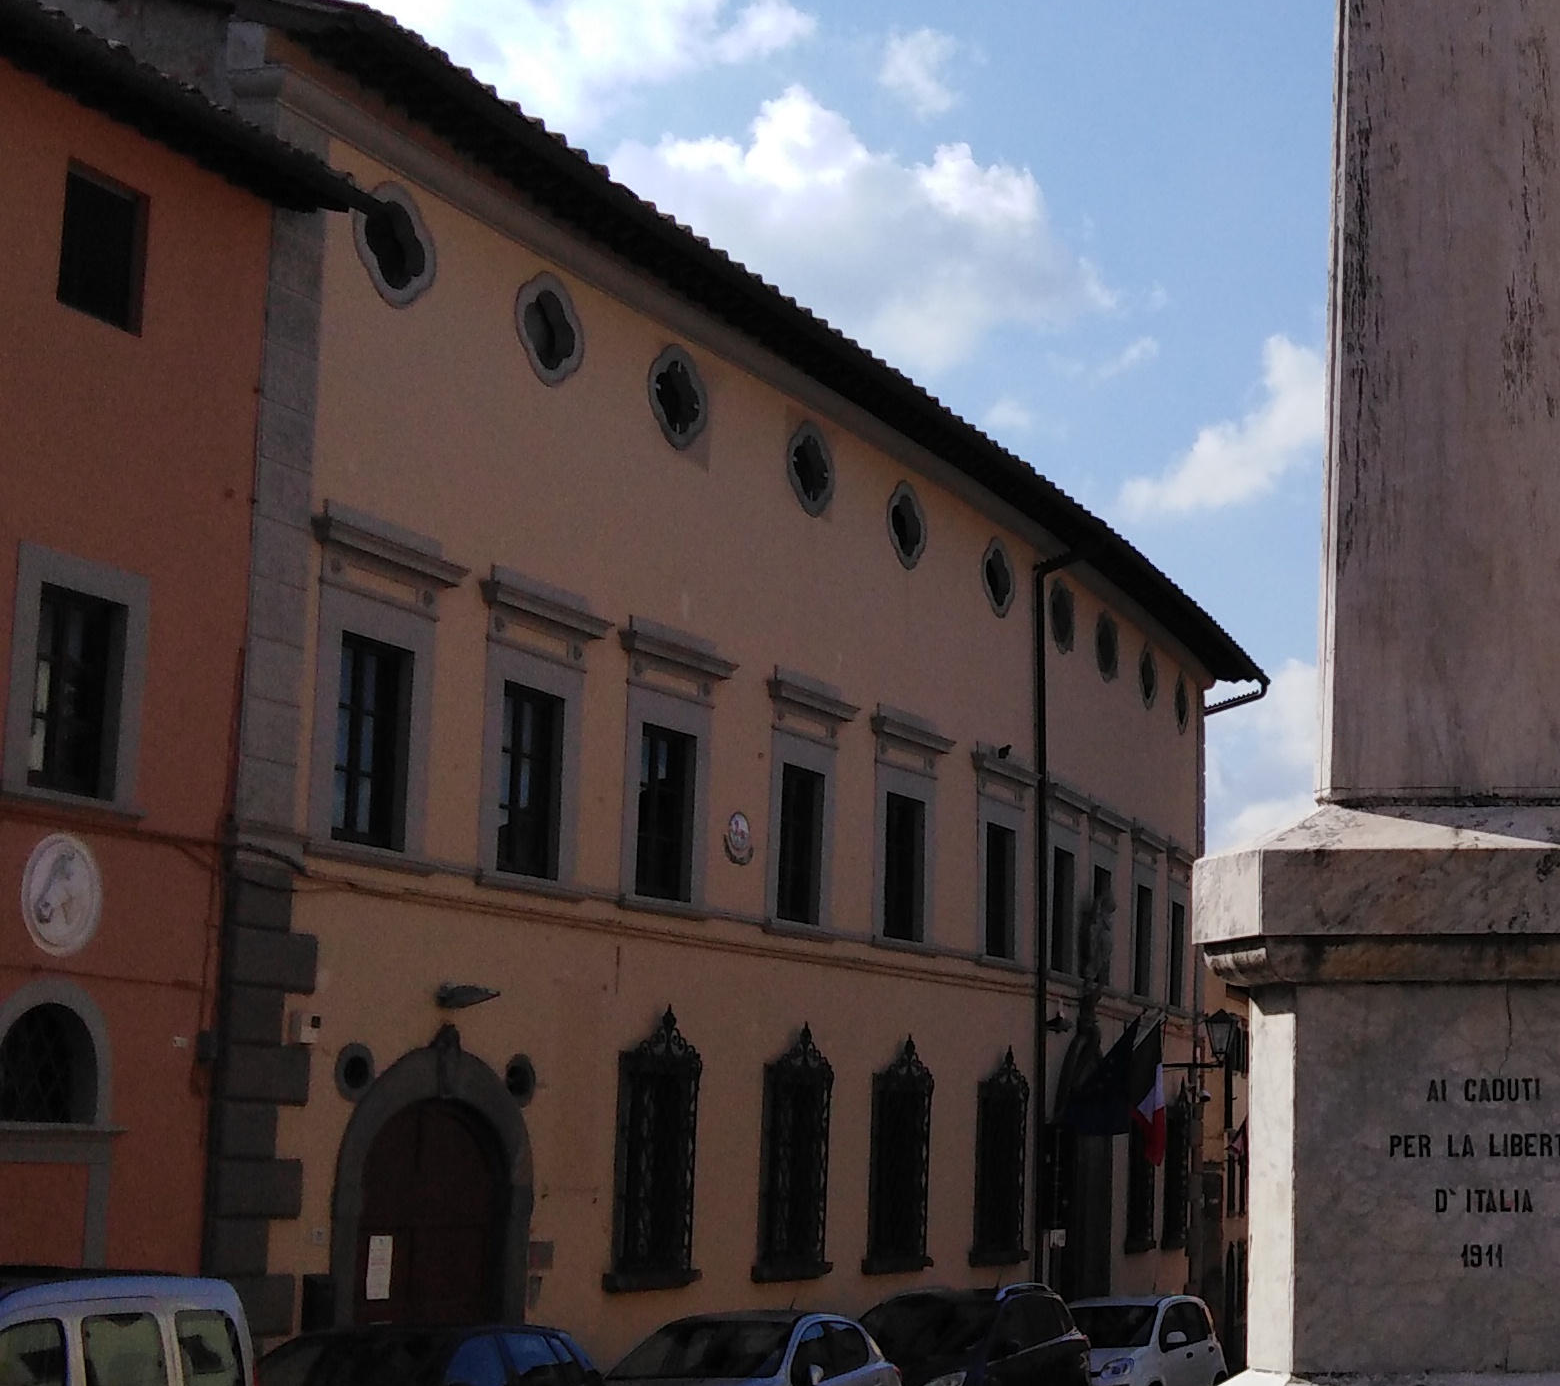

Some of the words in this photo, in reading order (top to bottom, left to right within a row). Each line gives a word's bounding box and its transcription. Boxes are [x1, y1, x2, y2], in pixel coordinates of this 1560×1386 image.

[1426, 1079, 1447, 1102] AI
[1464, 1078, 1541, 1102] CADUTI
[1389, 1134, 1432, 1158] PER
[1447, 1134, 1474, 1158] LA
